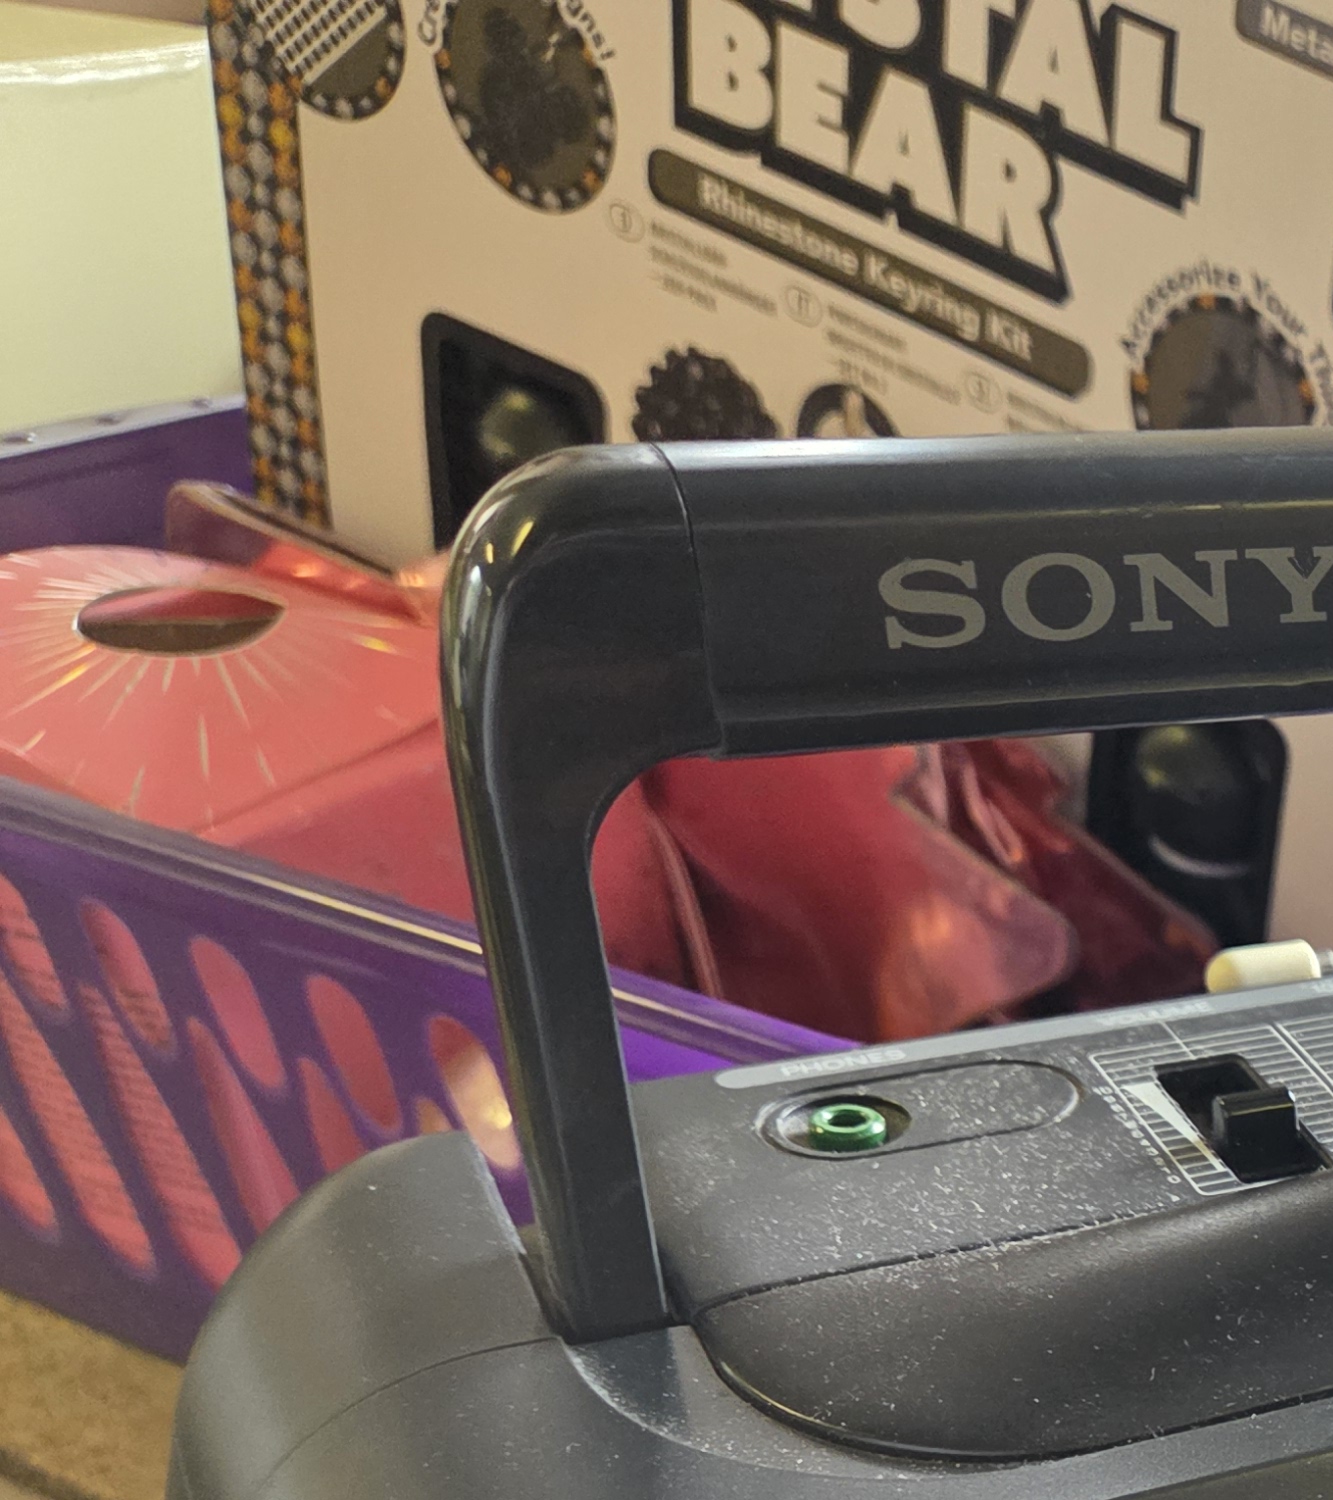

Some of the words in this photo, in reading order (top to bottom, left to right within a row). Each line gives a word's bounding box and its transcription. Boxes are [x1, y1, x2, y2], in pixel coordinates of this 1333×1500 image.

[686, 0, 1060, 282] BEAR
[702, 172, 860, 277] Rhinestone
[866, 248, 981, 343] Keyring
[984, 306, 1034, 362] Kit
[780, 1048, 907, 1077] PHONES
